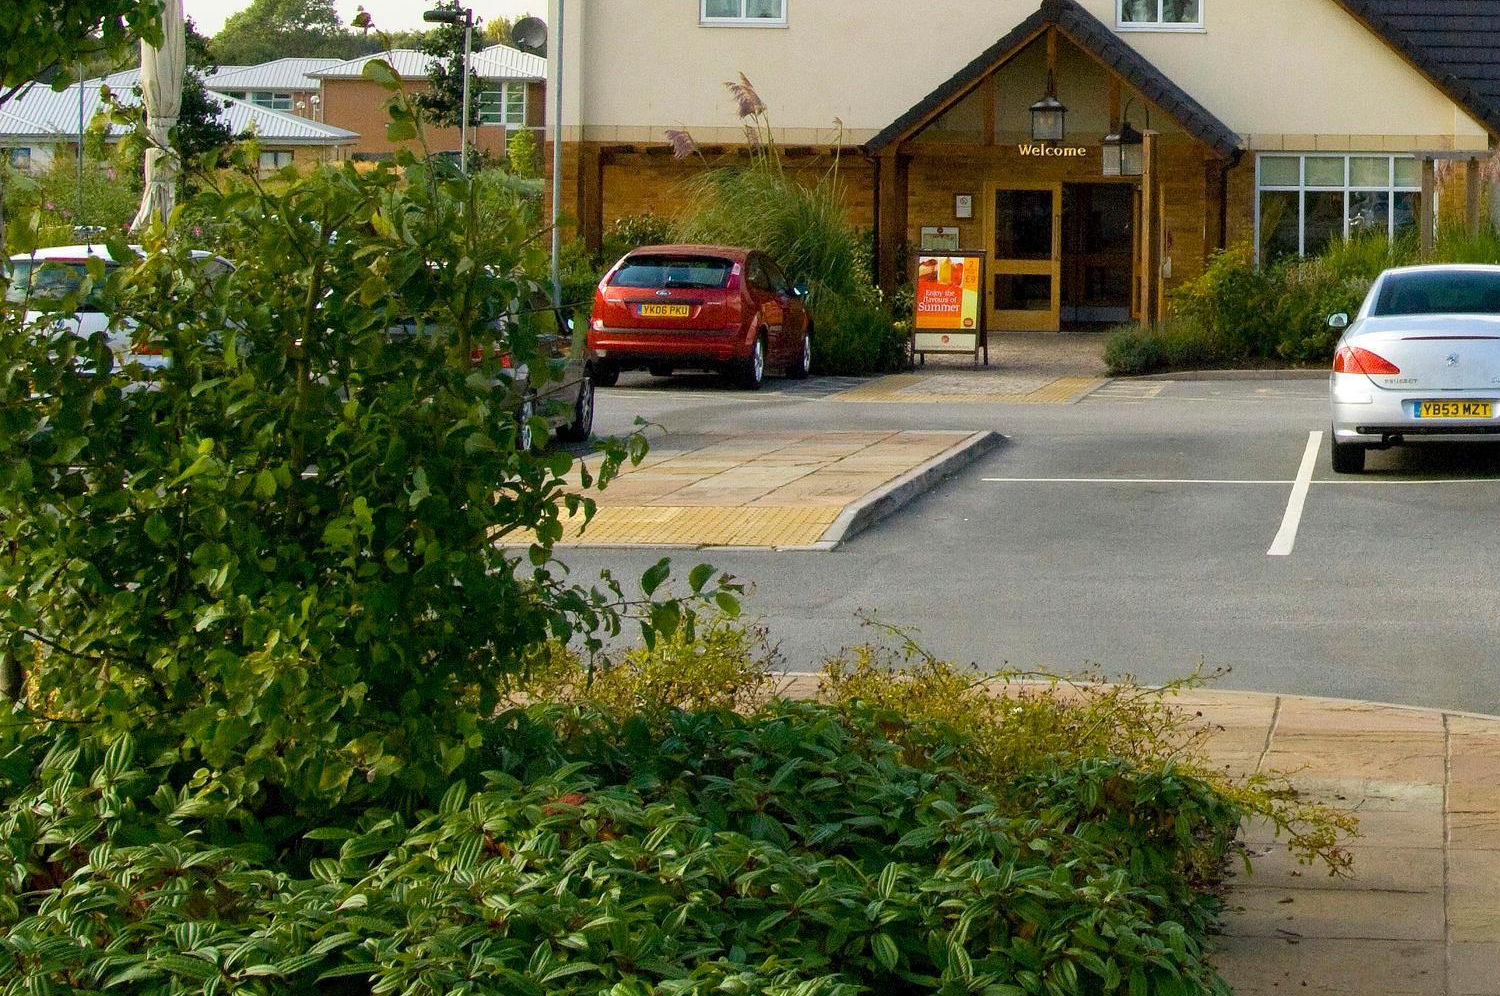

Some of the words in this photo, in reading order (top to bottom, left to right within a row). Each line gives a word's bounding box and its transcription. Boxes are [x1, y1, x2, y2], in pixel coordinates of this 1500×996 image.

[1018, 143, 1087, 157] Welcome
[925, 289, 943, 297] Enjoy
[643, 305, 668, 315] YK06
[669, 305, 688, 315] PKU
[918, 301, 960, 312] Summer
[1423, 403, 1459, 415] YB53
[1462, 403, 1490, 415] MZT
